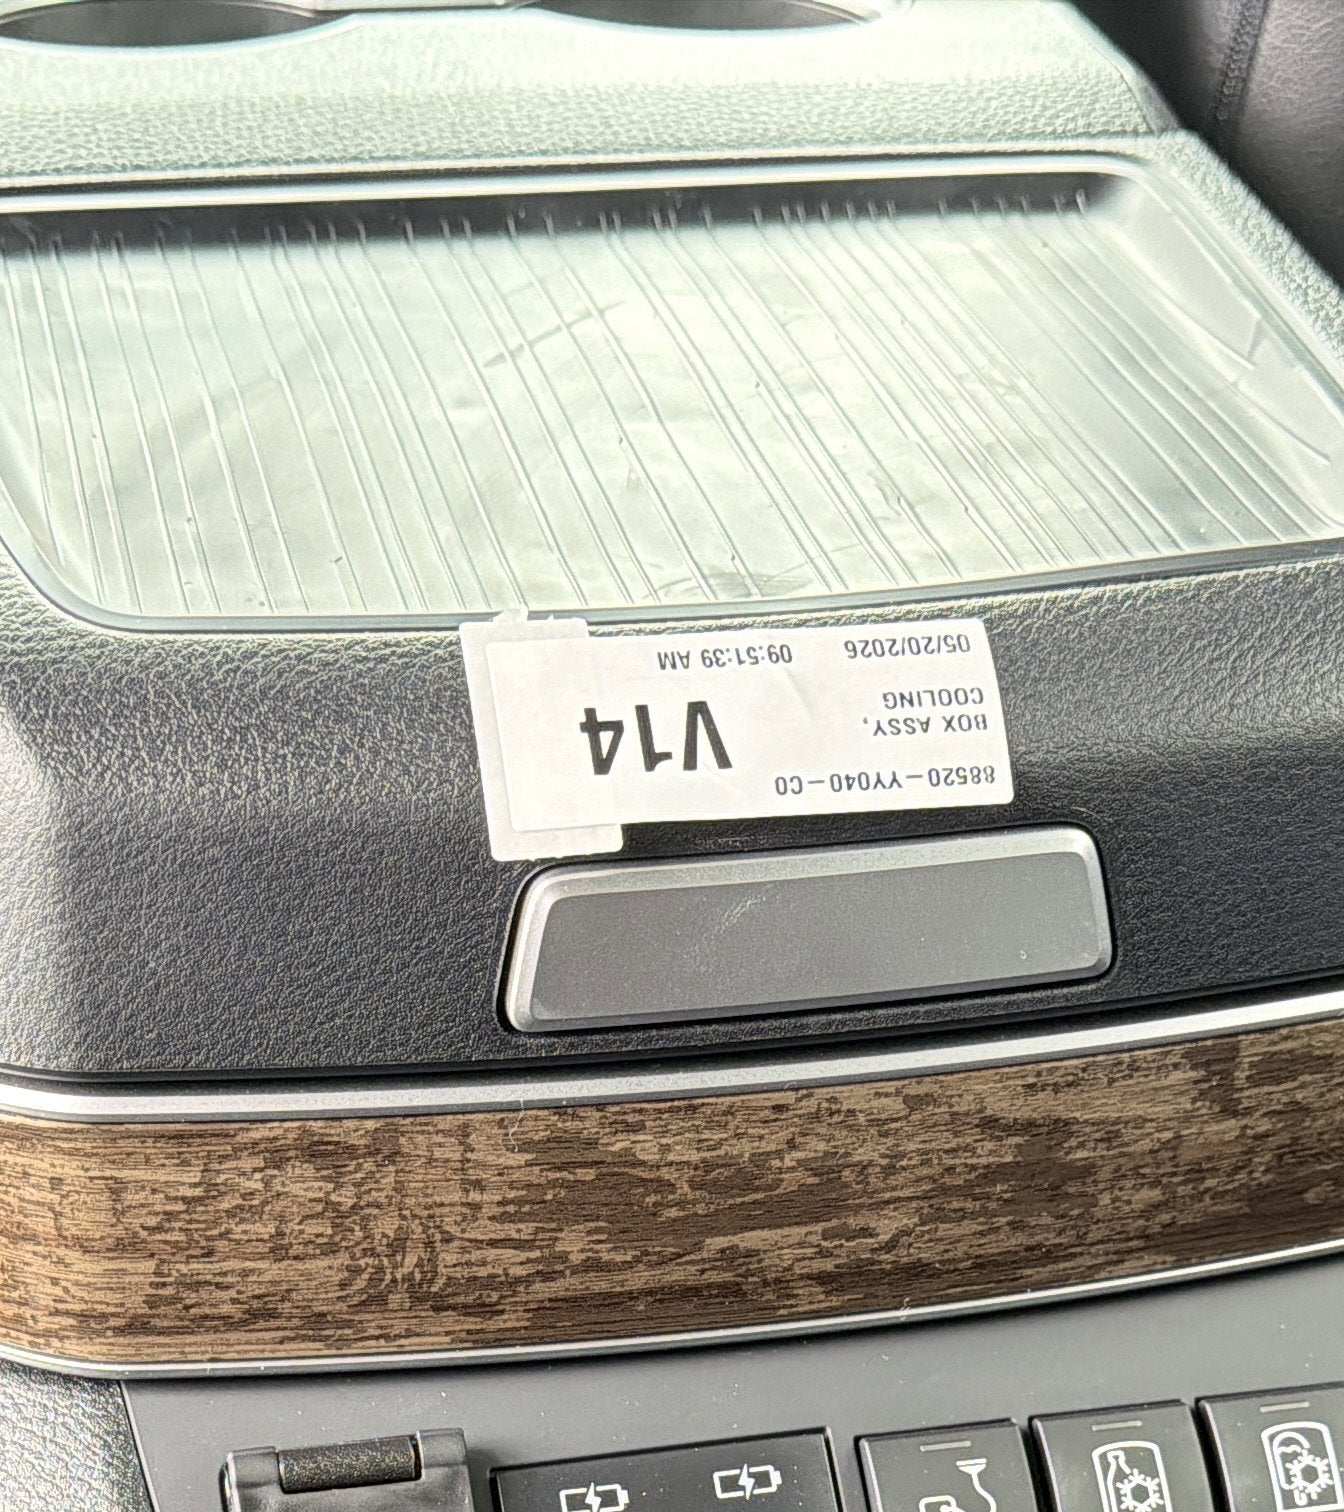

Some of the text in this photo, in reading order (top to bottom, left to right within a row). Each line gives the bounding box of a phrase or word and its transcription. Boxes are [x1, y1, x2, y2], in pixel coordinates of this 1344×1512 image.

[656, 633, 972, 671] 05/20/2026 09:51:39 AM
[882, 686, 984, 710] COOLING
[579, 700, 733, 776] V14
[862, 713, 988, 738] BOX ASSY,
